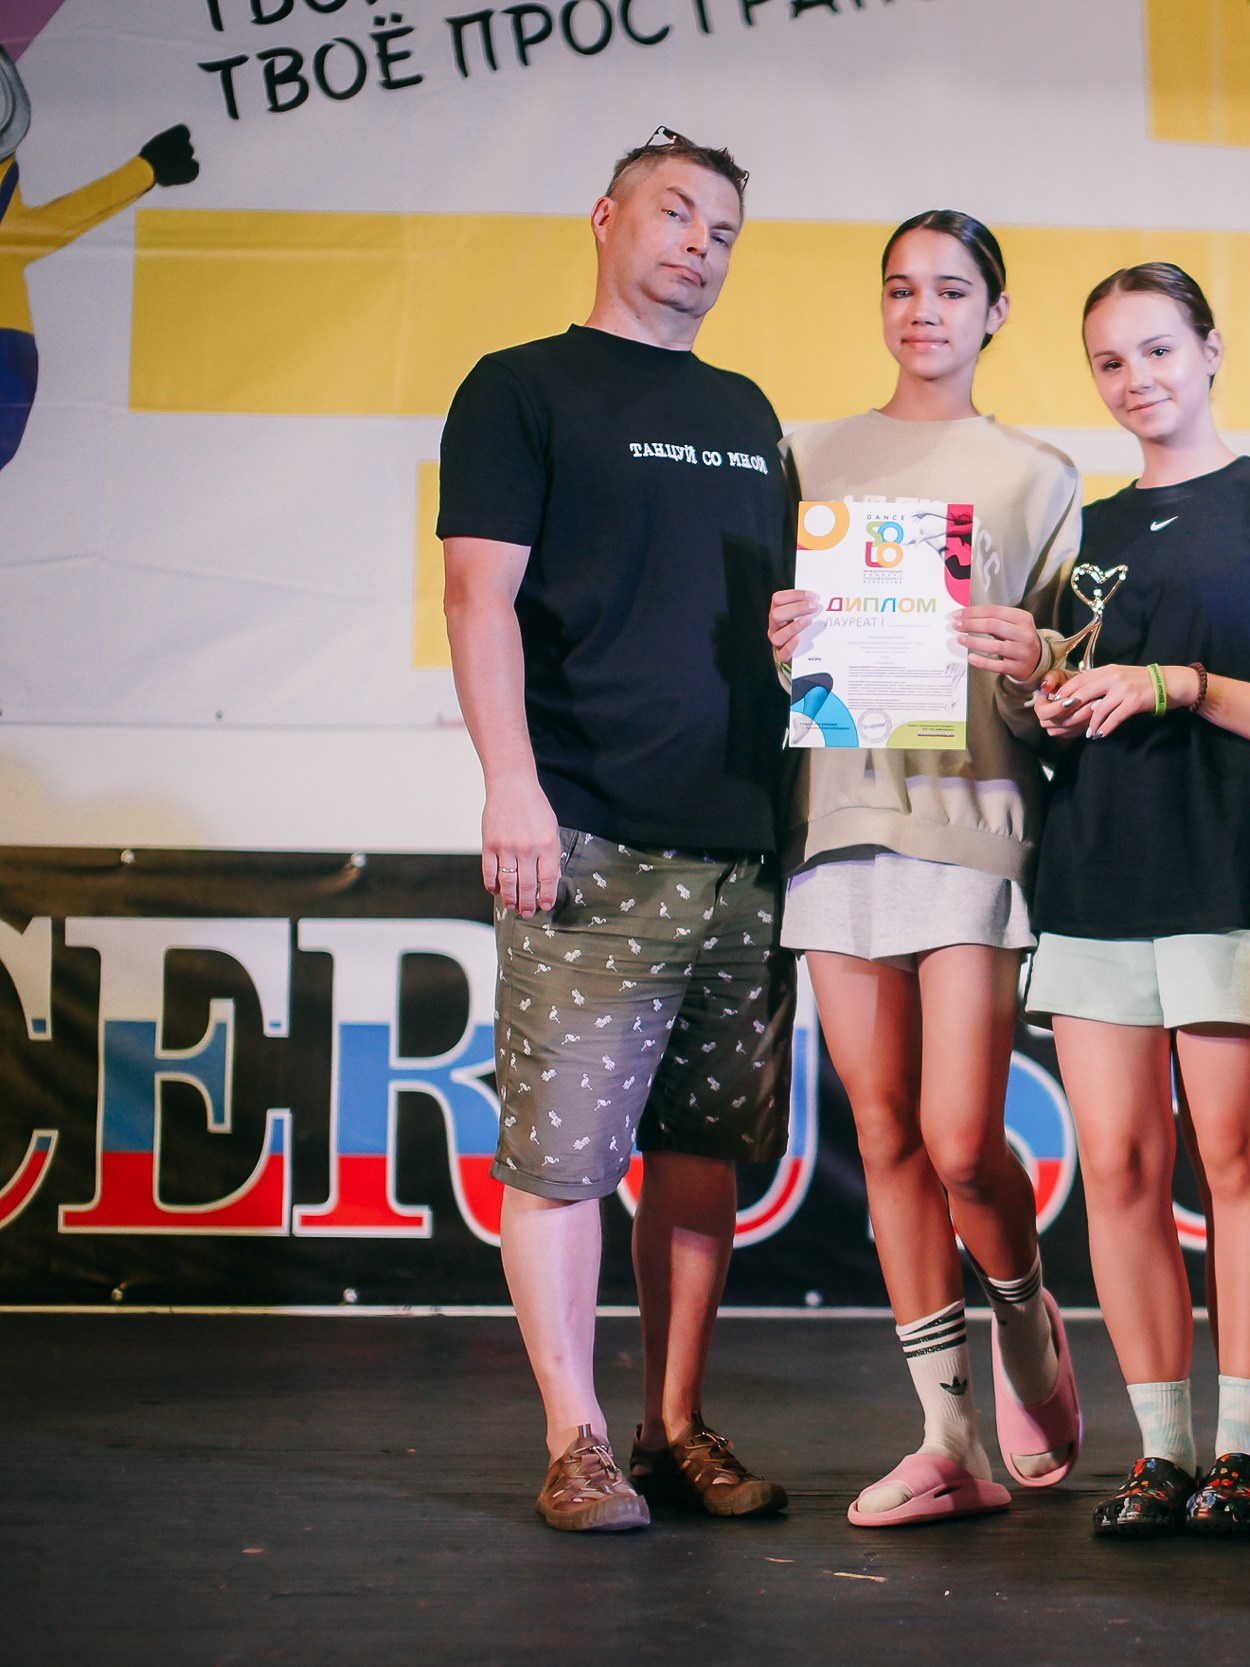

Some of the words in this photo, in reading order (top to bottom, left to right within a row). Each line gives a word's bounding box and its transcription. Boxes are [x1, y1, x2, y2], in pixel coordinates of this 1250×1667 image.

[197, 12, 424, 120] ТВОЁ
[629, 442, 698, 465] ТАНЦУЙ
[702, 450, 722, 466] СО
[727, 451, 769, 475] МНОЙ
[826, 597, 936, 613] ДИПЛОМ
[824, 617, 877, 628] ЛАУРЕАТ
